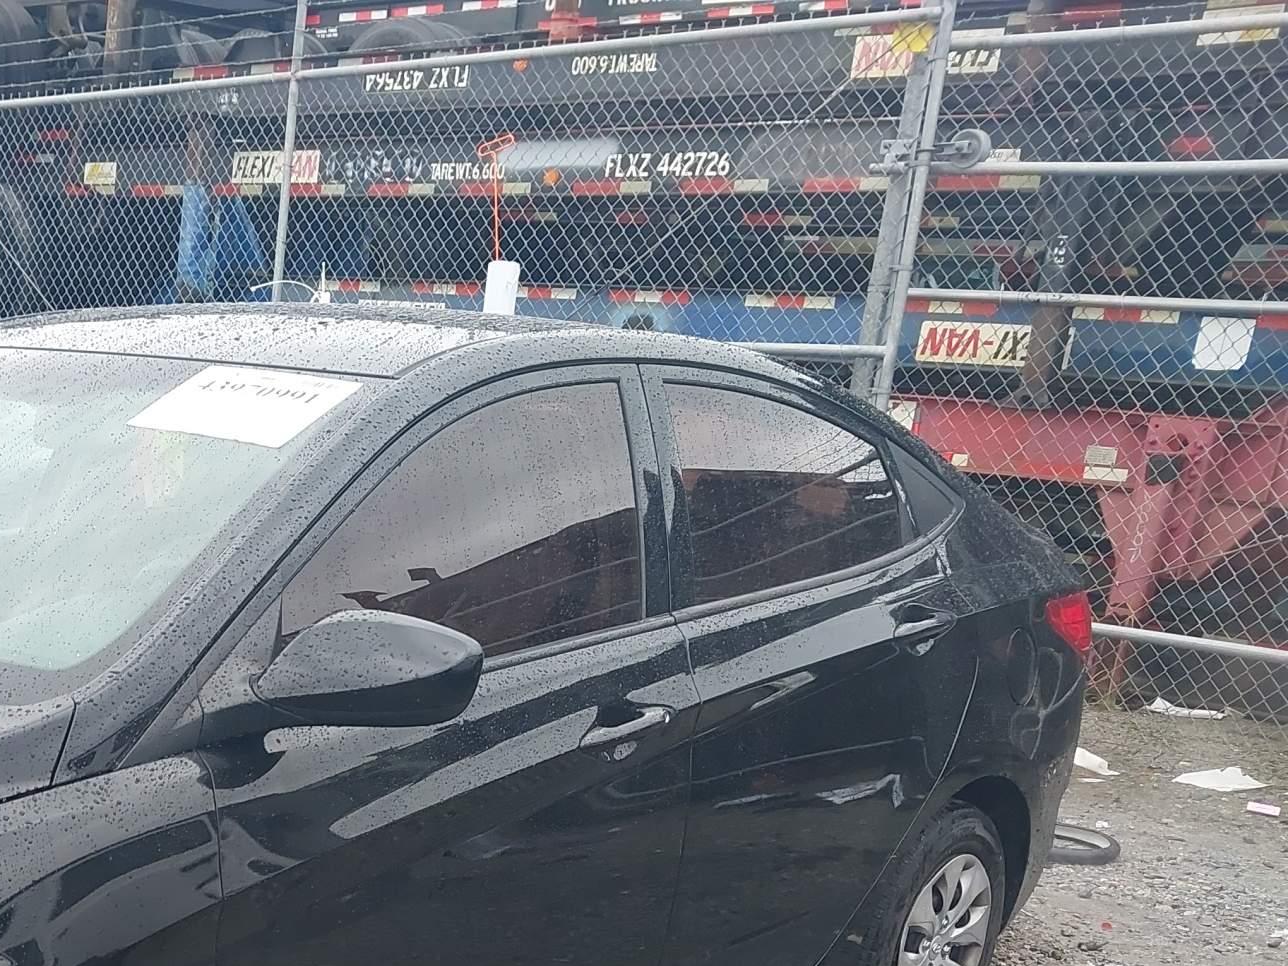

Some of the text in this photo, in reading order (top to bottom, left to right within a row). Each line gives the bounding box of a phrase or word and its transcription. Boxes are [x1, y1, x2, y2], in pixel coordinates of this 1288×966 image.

[233, 153, 319, 180] FLEXI-AN
[605, 152, 730, 178] FLXZ 442726
[919, 327, 1030, 362] XI-VAN
